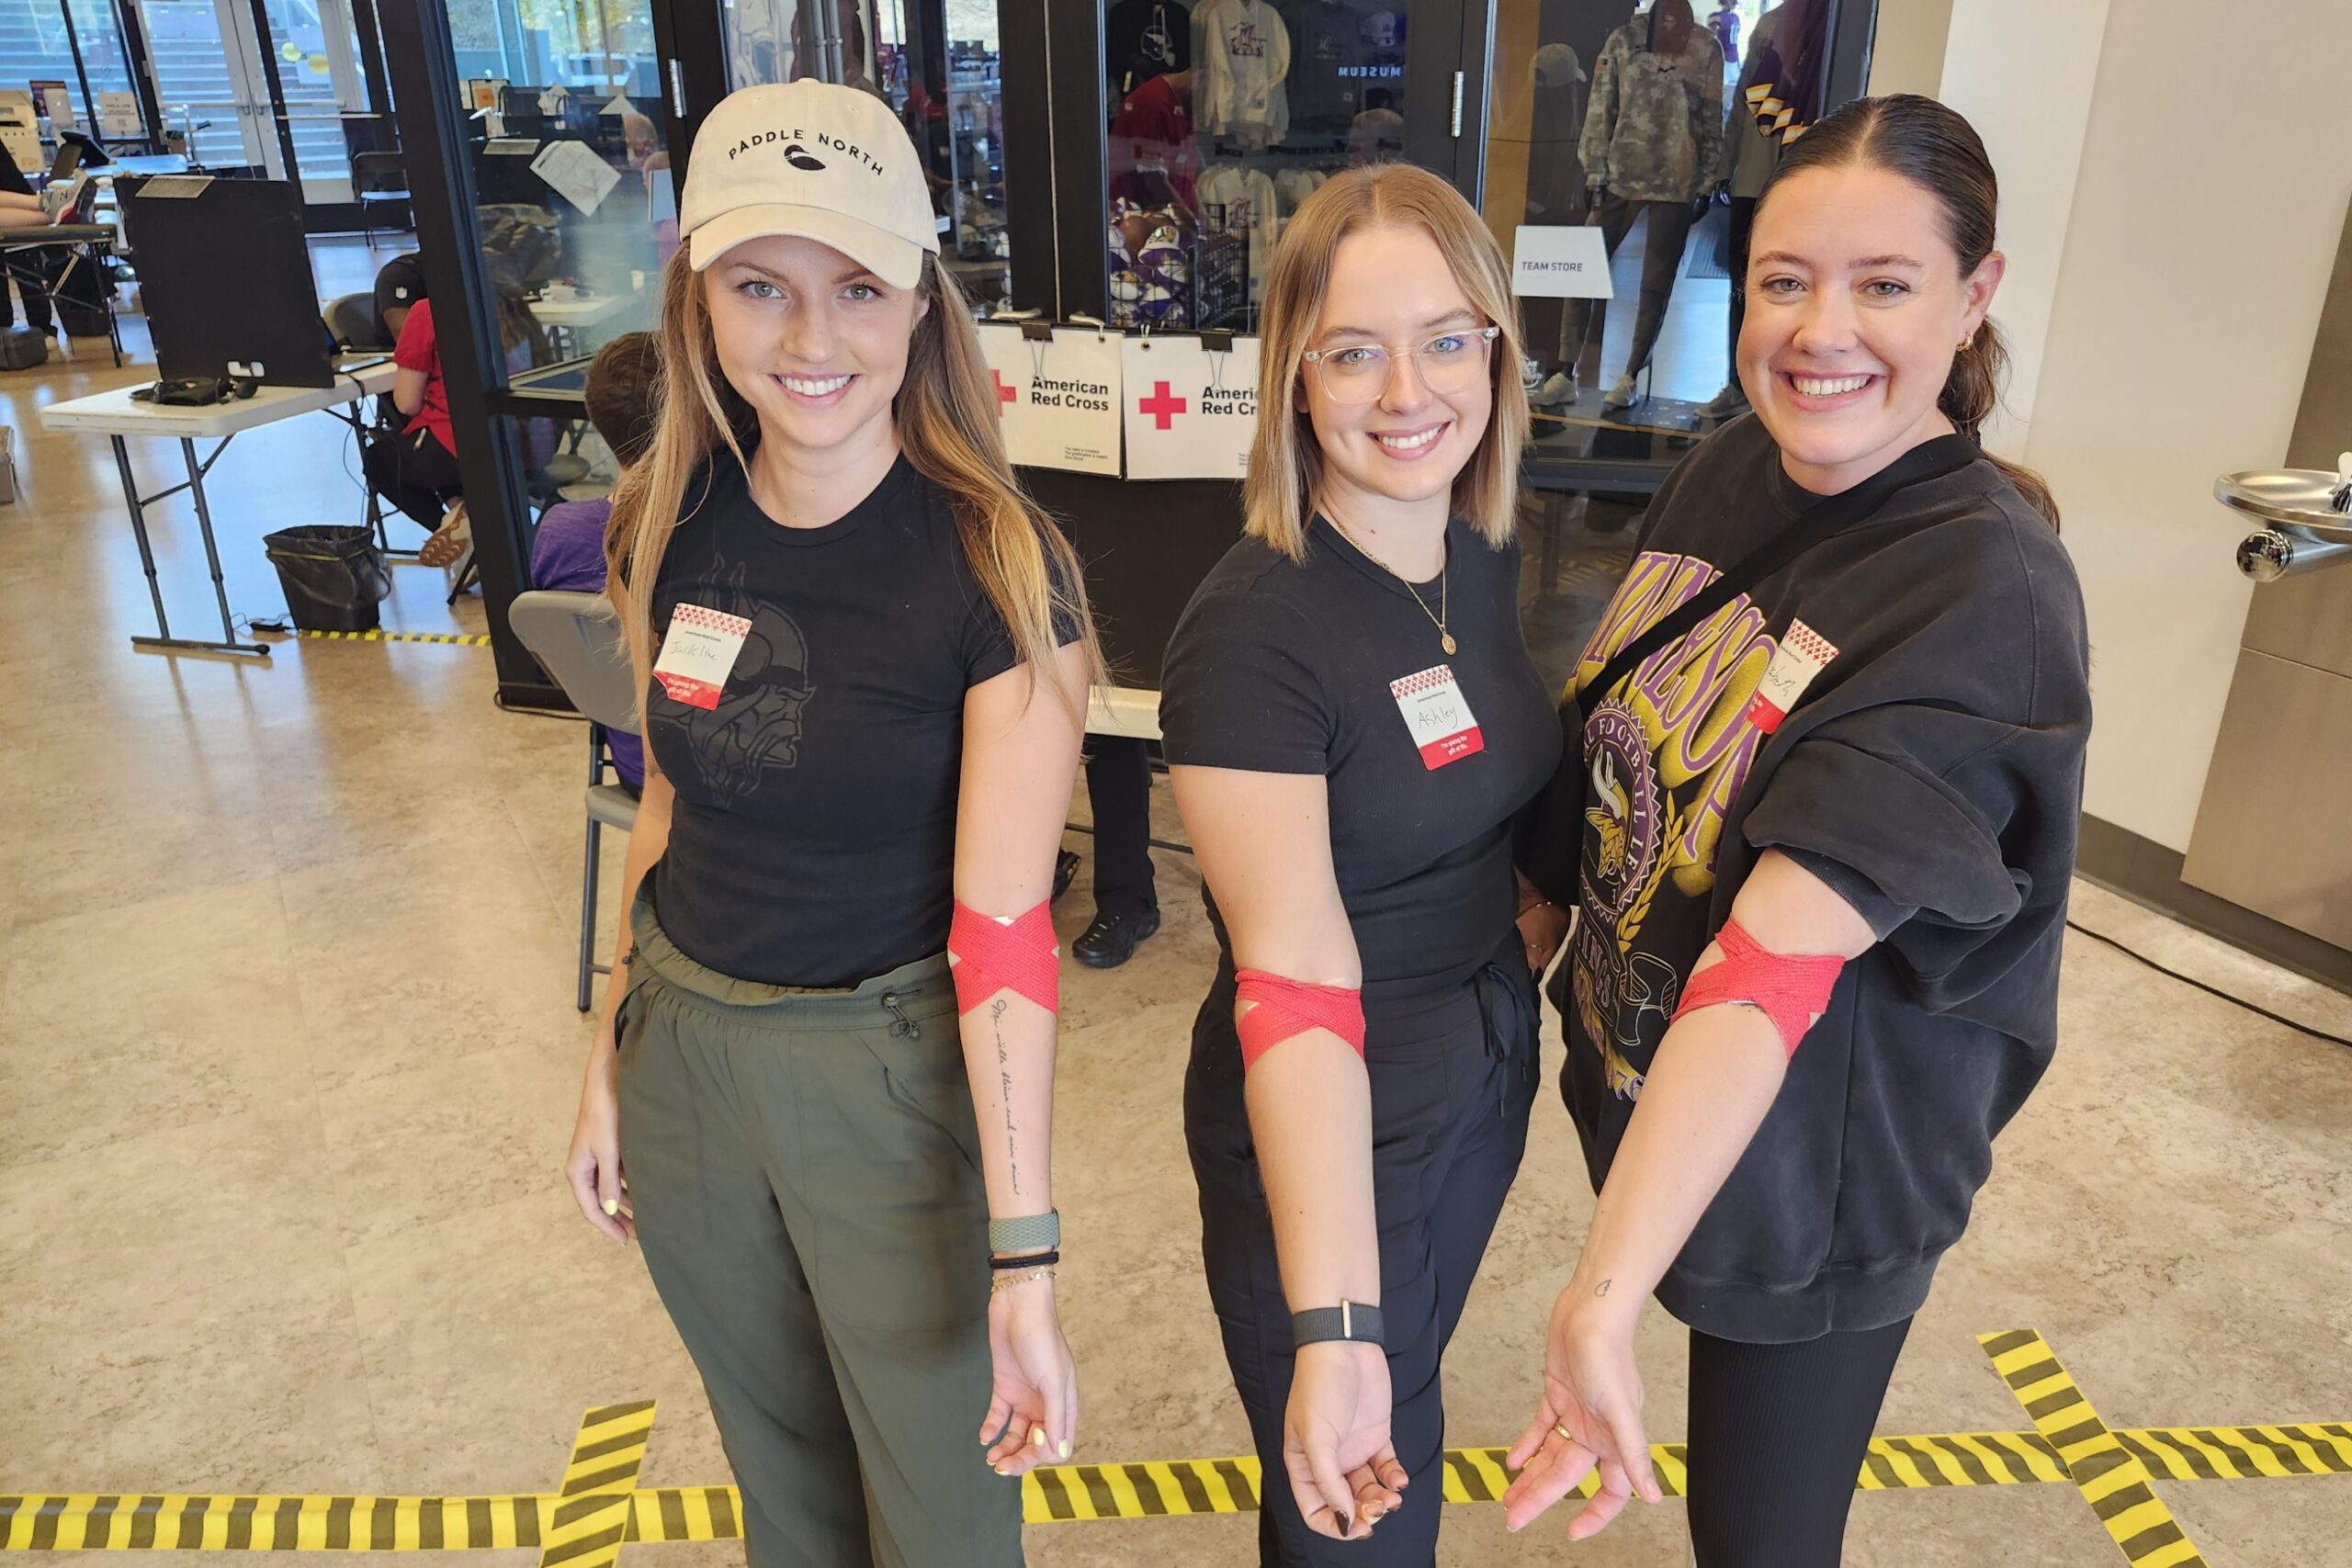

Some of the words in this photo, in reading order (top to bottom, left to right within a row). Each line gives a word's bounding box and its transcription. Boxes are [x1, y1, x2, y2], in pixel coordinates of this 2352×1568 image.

[729, 130, 804, 160] PADDLE
[819, 132, 884, 175] NORTH
[1521, 261, 1549, 271] TEAM
[1551, 262, 1583, 272] STORE
[1032, 376, 1109, 395] American
[1203, 387, 1259, 400] Americ
[1032, 392, 1060, 407] Red
[1065, 394, 1109, 412] Cross
[1203, 402, 1233, 414] Red
[1419, 705, 1458, 729] Ashley
